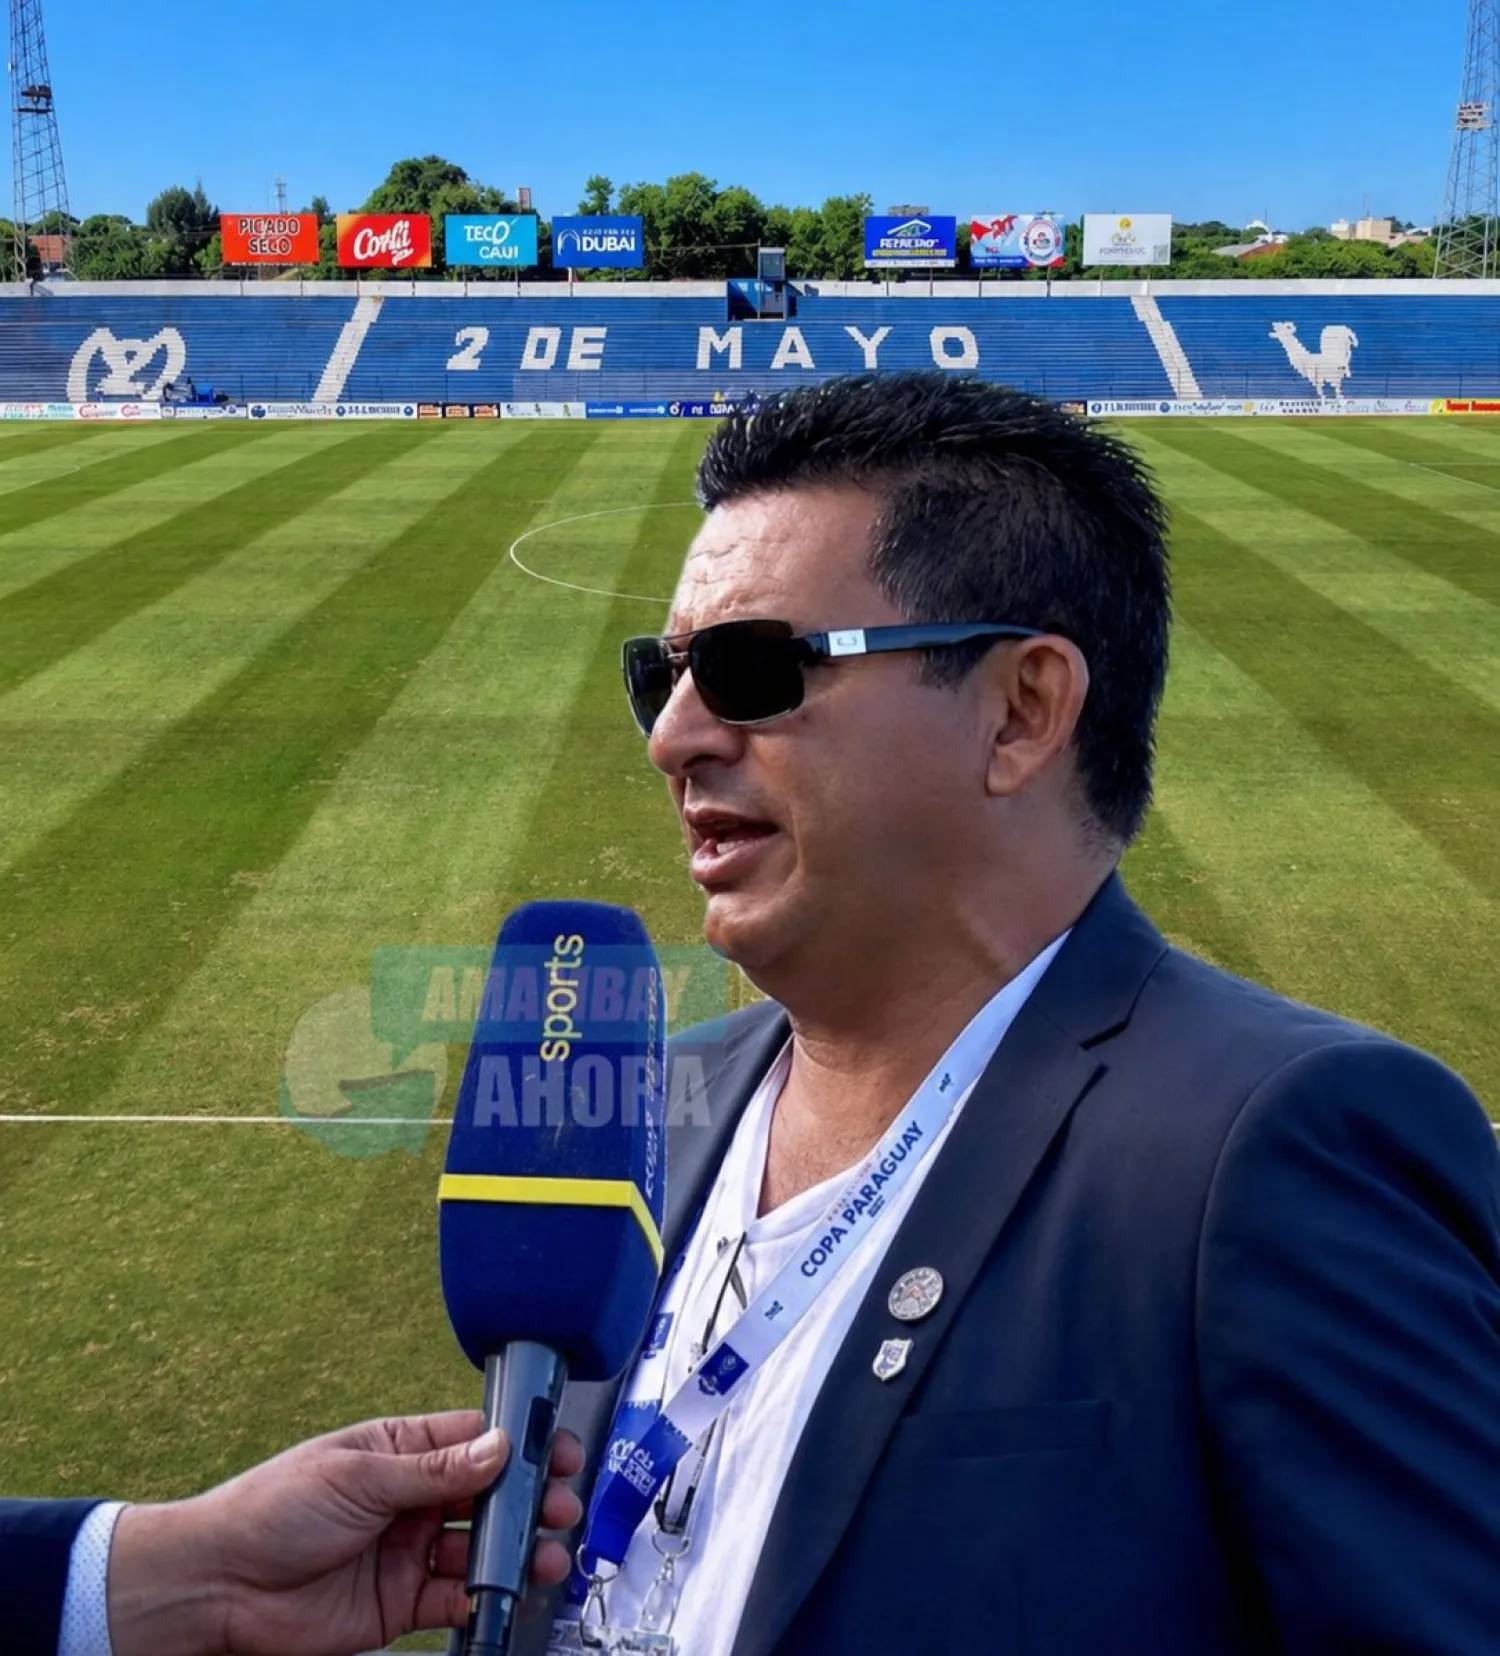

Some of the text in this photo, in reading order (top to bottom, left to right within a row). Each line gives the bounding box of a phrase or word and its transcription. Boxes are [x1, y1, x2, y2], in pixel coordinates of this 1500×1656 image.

[238, 217, 300, 235] PICADO
[582, 235, 635, 252] DUBAI
[445, 326, 981, 371] 2 DE MAYO
[540, 933, 584, 1062] sports
[800, 1225, 849, 1278] COPA
[842, 1120, 924, 1226] PARAGUAY
